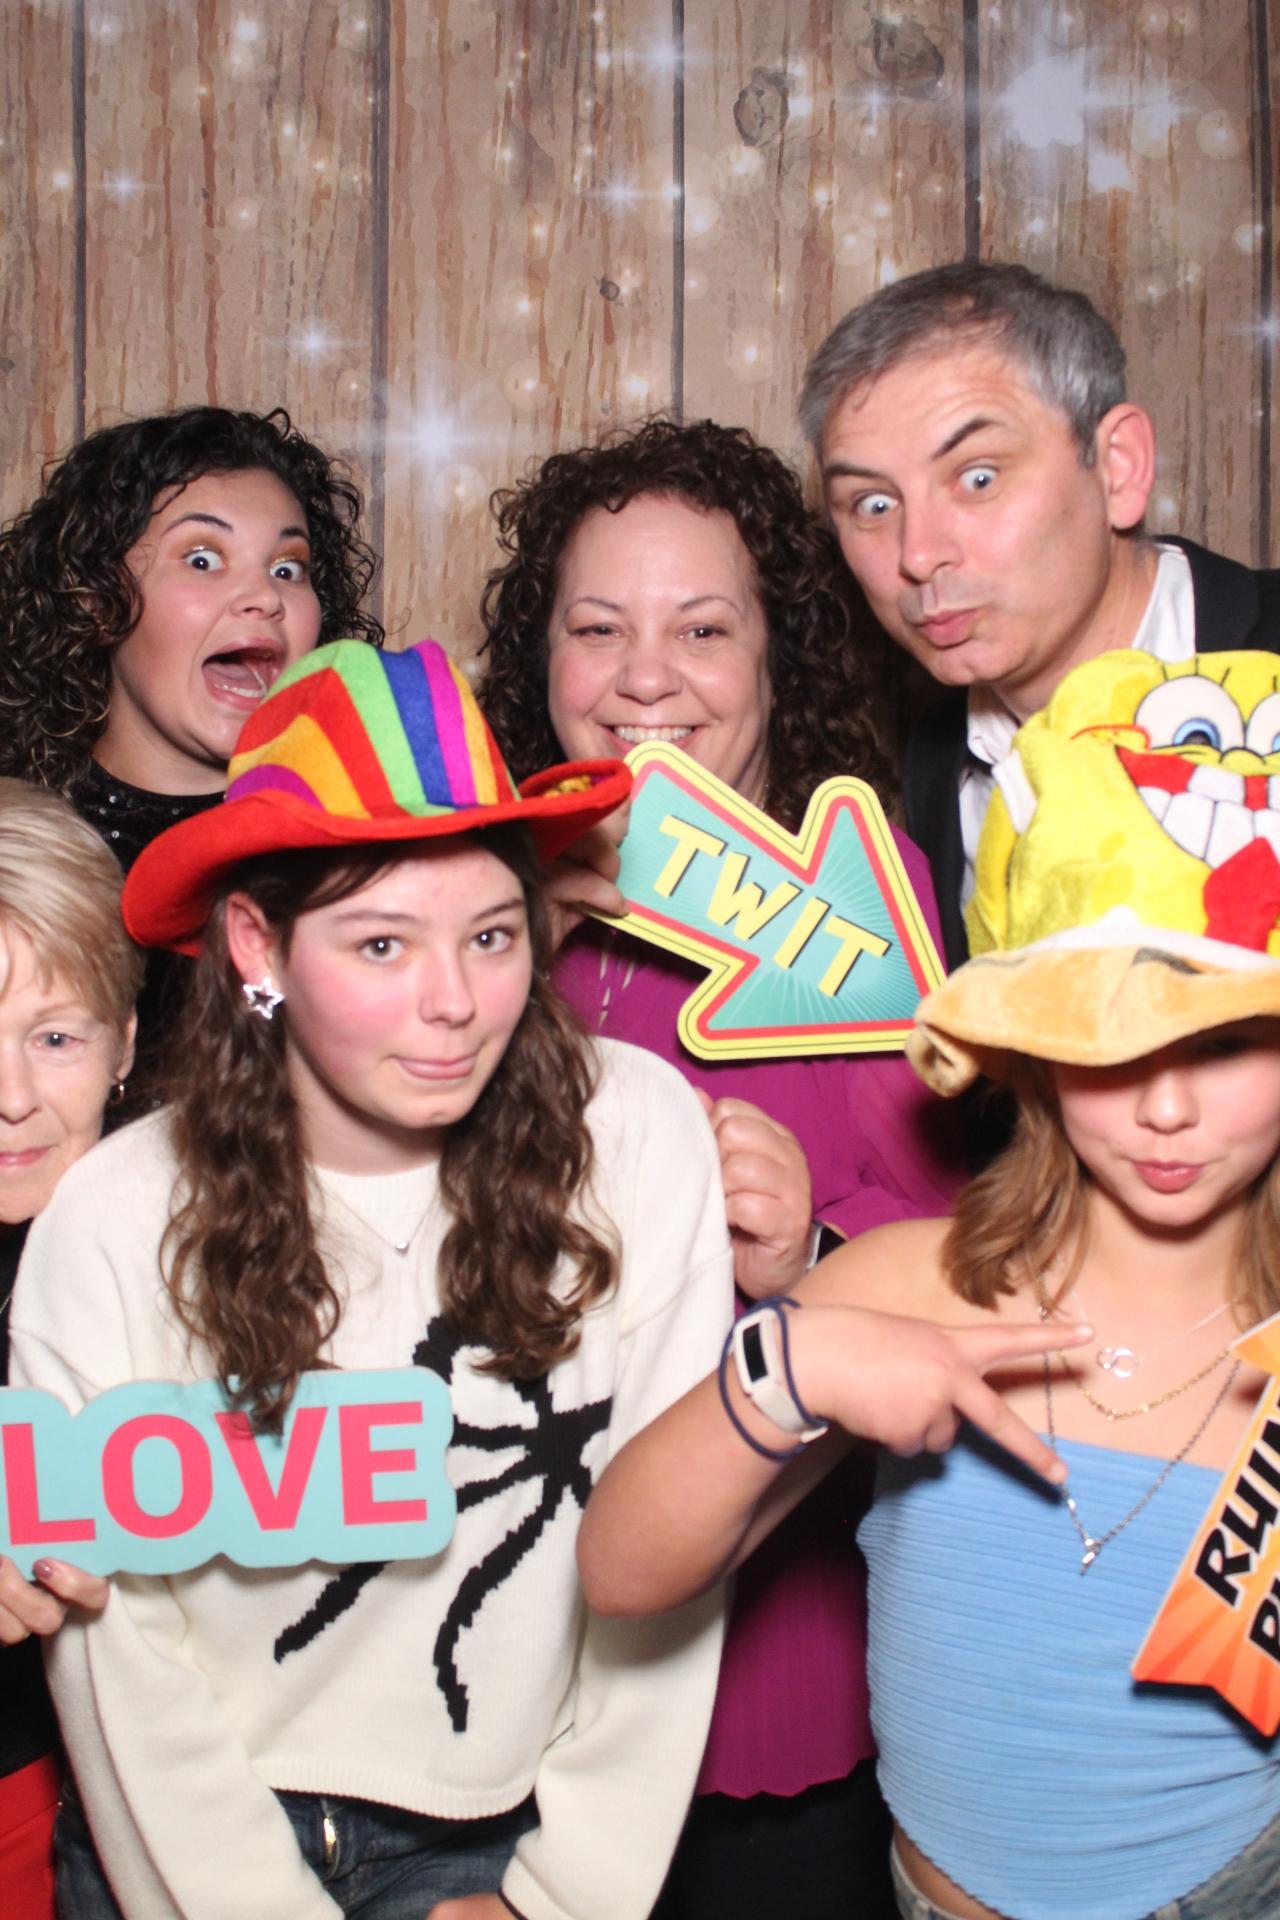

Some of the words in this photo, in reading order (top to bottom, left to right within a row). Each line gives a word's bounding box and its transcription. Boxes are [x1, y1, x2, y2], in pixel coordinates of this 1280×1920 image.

[653, 813, 892, 997] TWIT
[2, 1401, 428, 1546] LOVE
[1195, 1391, 1280, 1607] RUI
